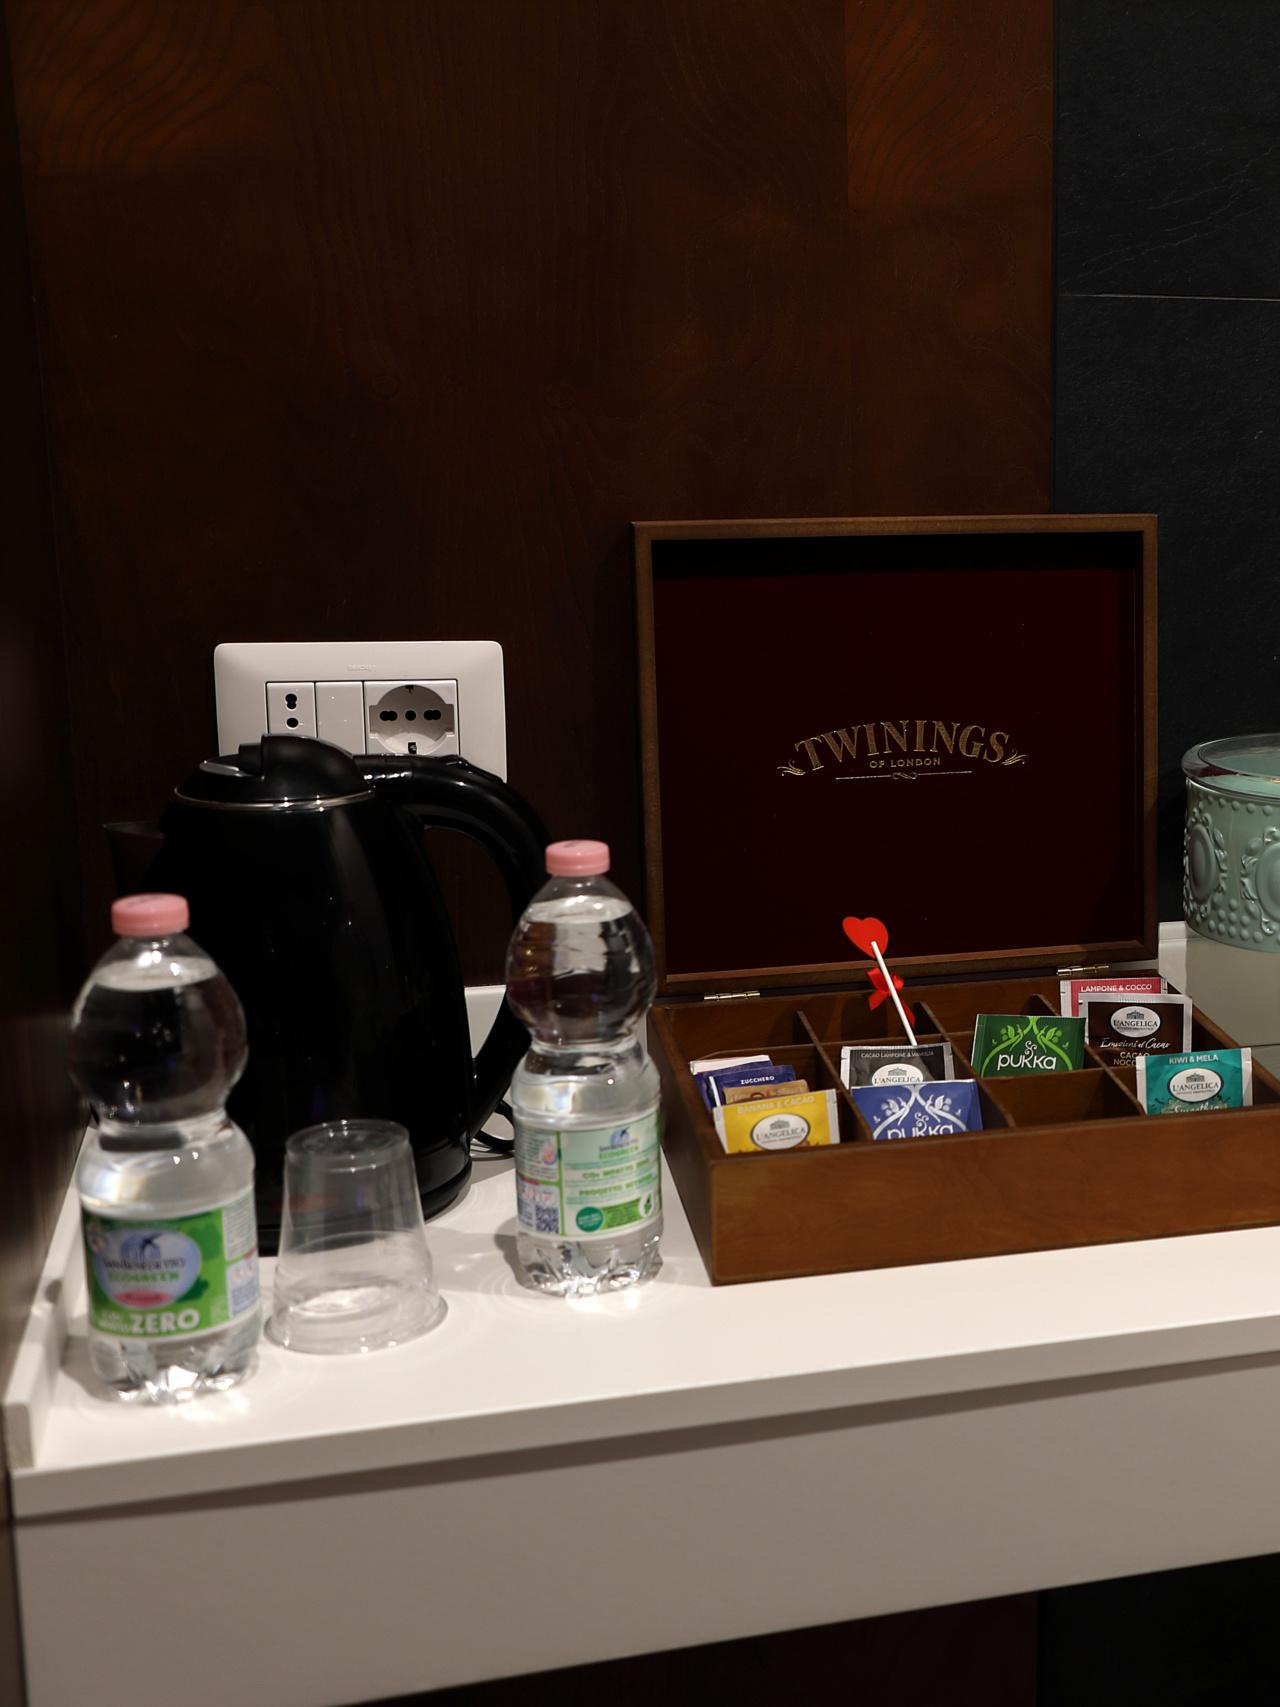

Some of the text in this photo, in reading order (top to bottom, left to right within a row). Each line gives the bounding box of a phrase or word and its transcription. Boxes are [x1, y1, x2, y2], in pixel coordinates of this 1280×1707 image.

[794, 719, 1010, 771] TWININGS
[869, 757, 941, 769] OF LONDON
[1081, 984, 1118, 993] LAMPONE
[1125, 983, 1153, 991] COCCO
[1113, 1019, 1159, 1028] L'ANGELICA
[997, 1043, 1057, 1071] pukka
[1169, 1057, 1188, 1065] KIWI
[1196, 1054, 1219, 1062] MELA
[740, 1075, 775, 1085] ZUCCHERO
[874, 1076, 921, 1085] L'ANGELICA
[1172, 1081, 1219, 1092] L'ANGELICA
[129, 1307, 201, 1334] ZERO
